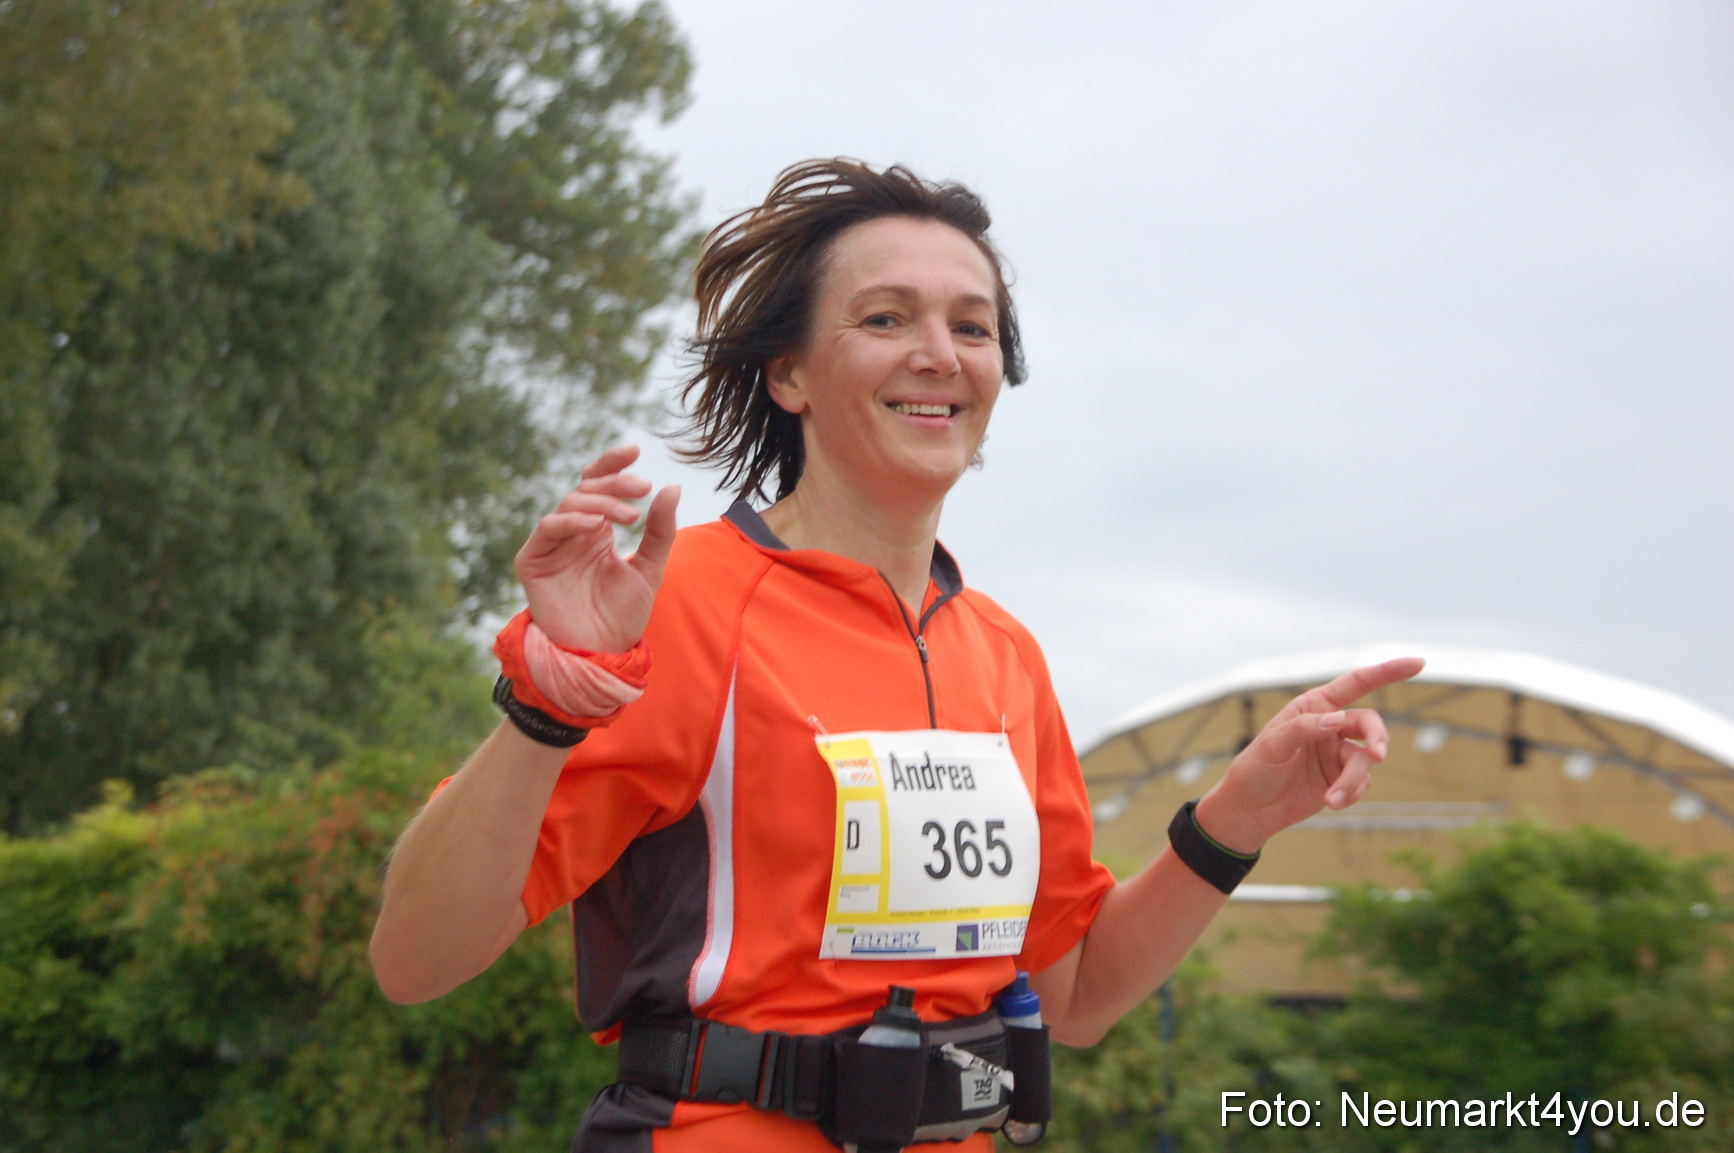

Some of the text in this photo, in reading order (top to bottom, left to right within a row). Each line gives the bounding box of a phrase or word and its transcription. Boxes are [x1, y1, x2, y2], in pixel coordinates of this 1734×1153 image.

[889, 751, 976, 792] Andrea
[846, 820, 860, 850] D
[921, 820, 1013, 880] 365
